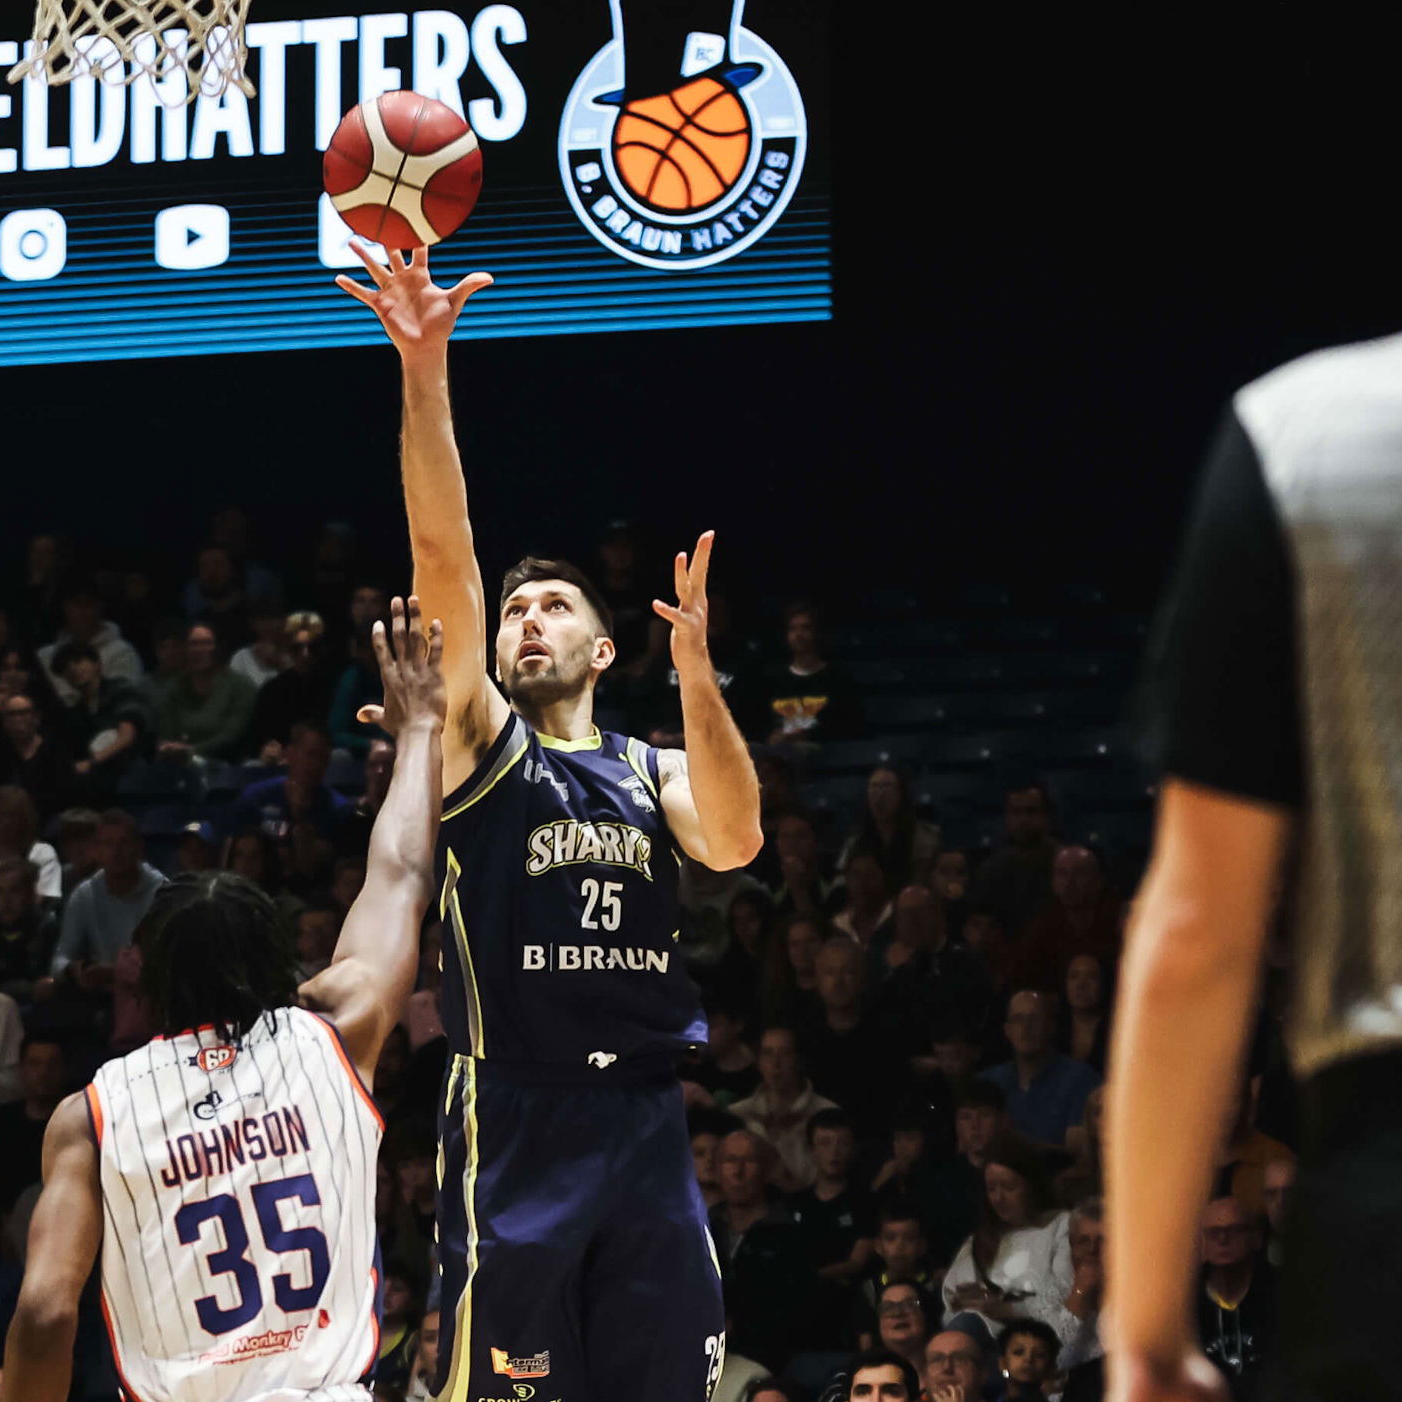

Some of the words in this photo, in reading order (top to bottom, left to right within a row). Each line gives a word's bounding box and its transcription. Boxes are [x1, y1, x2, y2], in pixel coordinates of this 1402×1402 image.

[591, 194, 682, 254] BRAUN
[690, 150, 789, 251] HATTERS
[581, 878, 624, 932] 25
[161, 1104, 311, 1188] JOHNSON
[174, 1173, 331, 1337] 35
